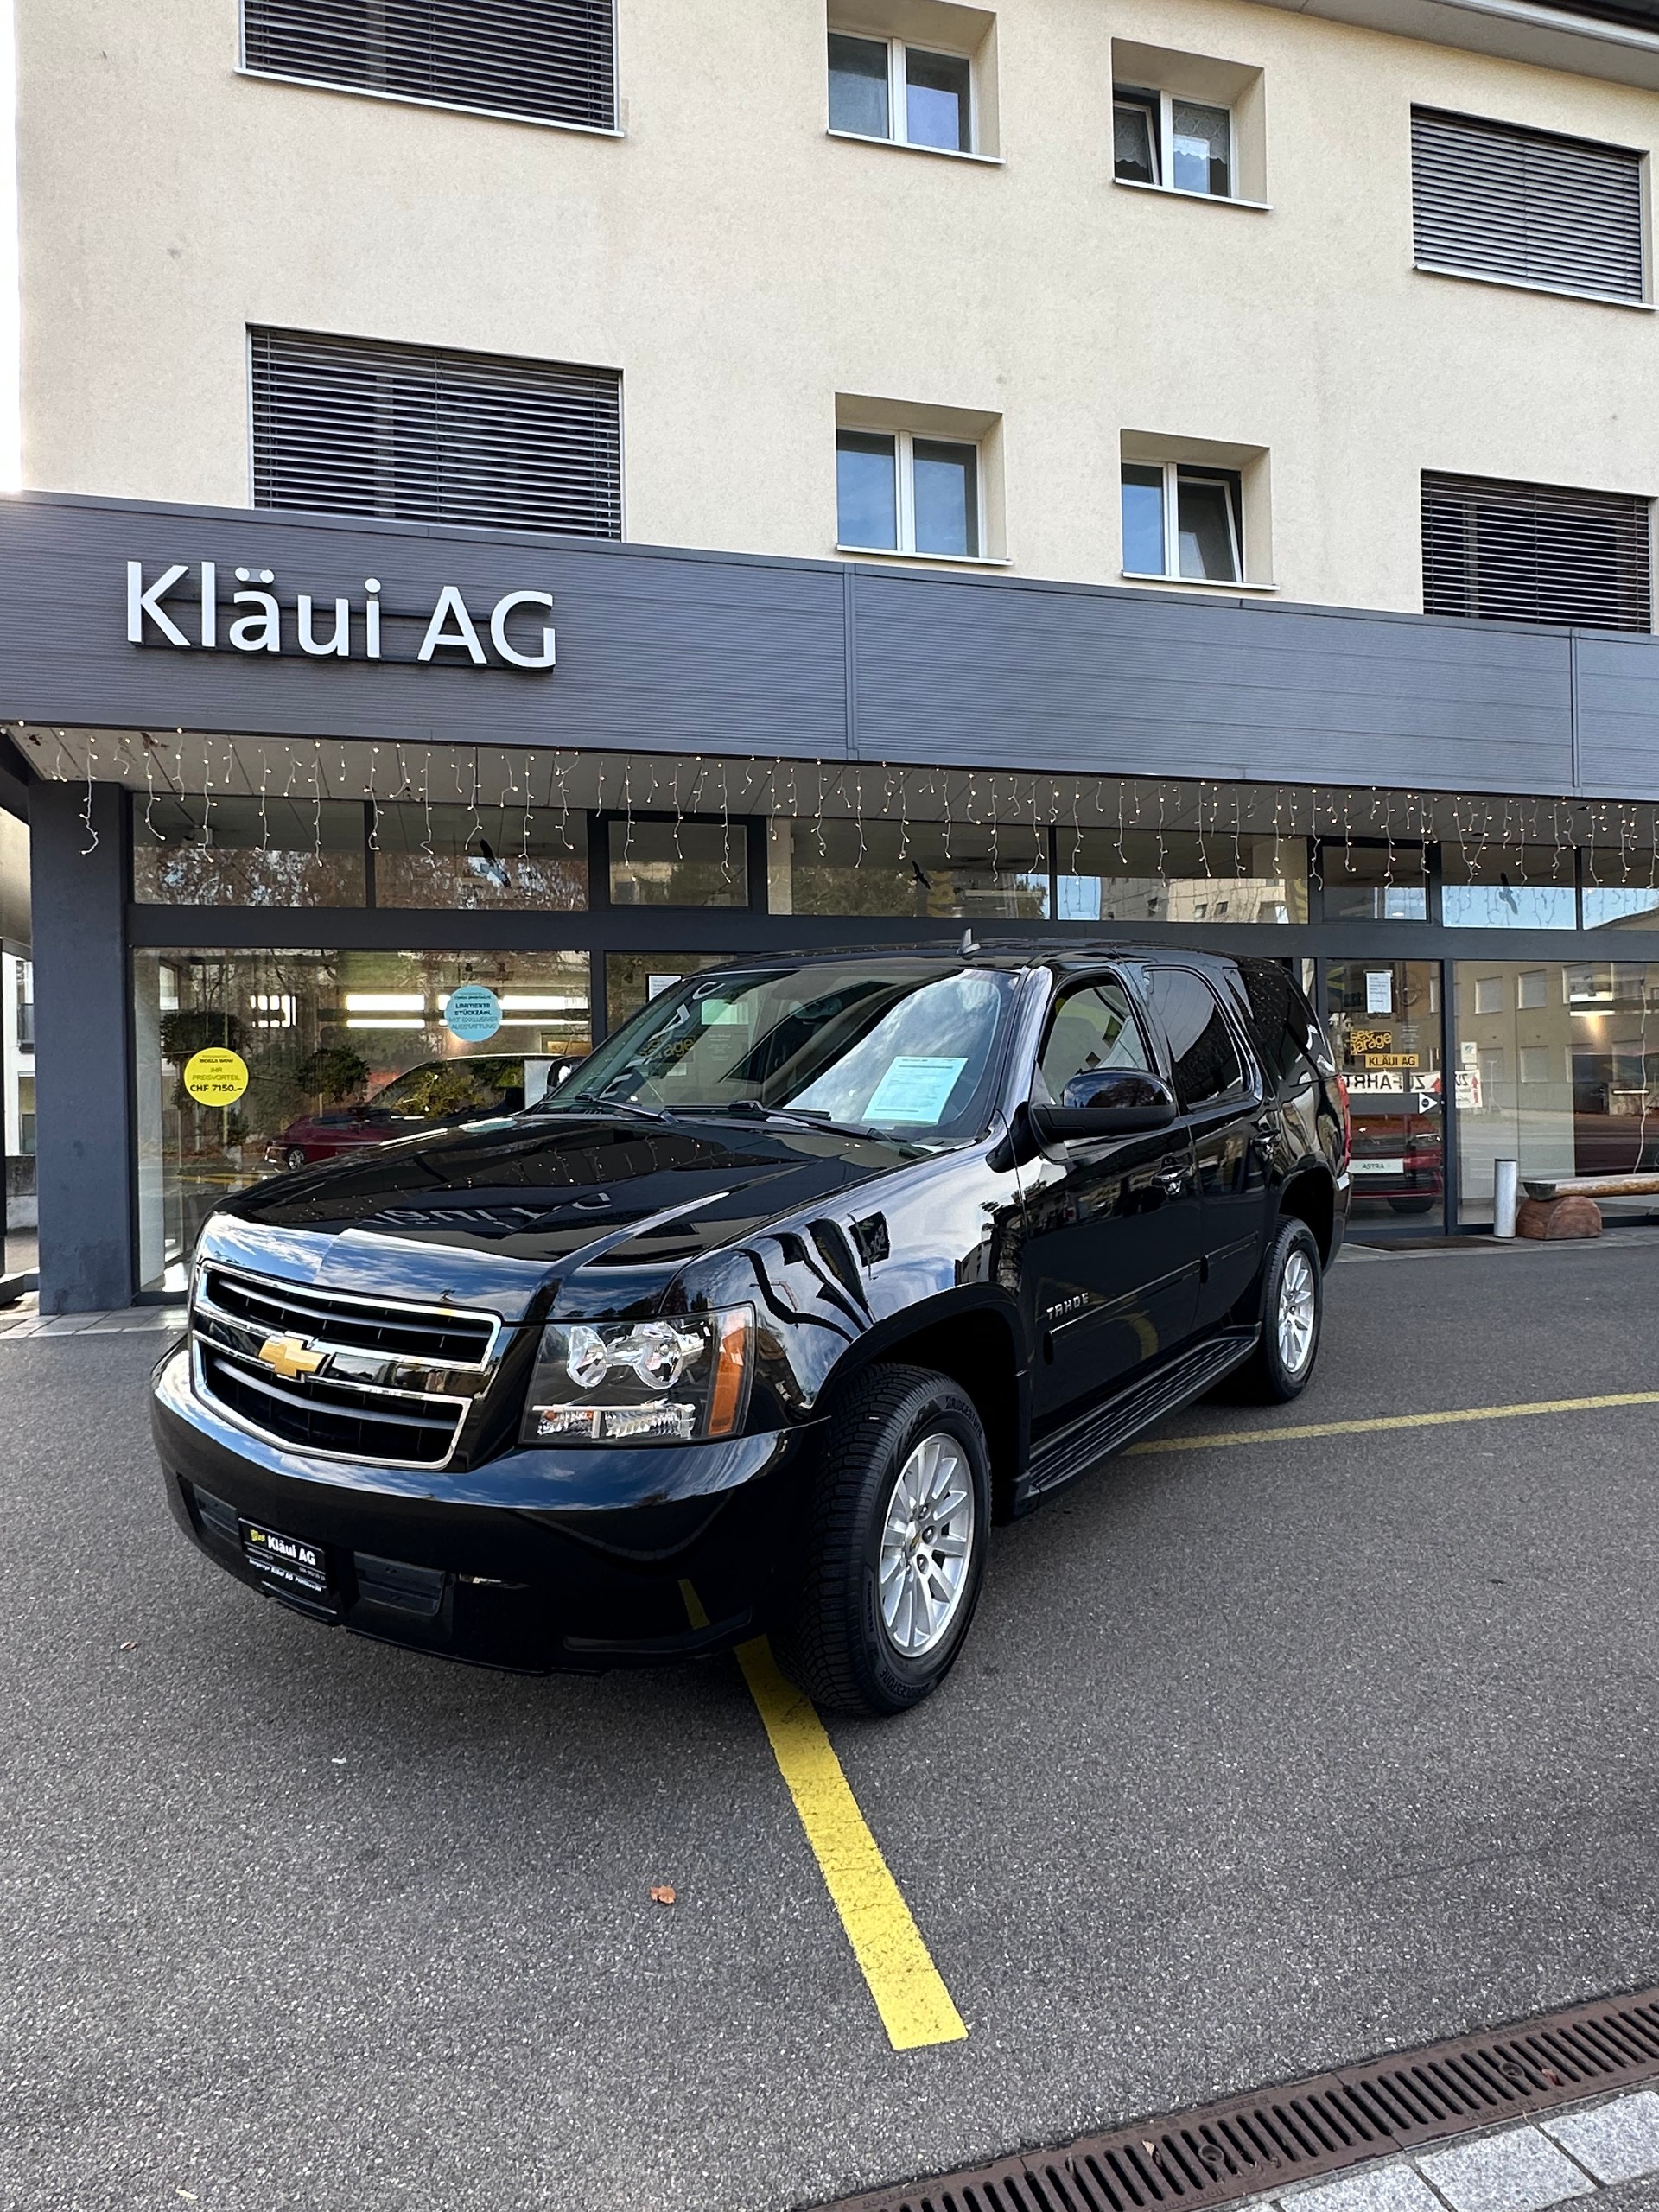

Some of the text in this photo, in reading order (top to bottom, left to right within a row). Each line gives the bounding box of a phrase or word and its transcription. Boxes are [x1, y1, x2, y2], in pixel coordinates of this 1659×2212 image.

[126, 560, 557, 670] Kläui AG
[1369, 1054, 1415, 1066] KLÄUI AG
[1046, 1292, 1089, 1320] TAHOE
[267, 1535, 296, 1558] Kläui
[298, 1548, 316, 1566] AG
